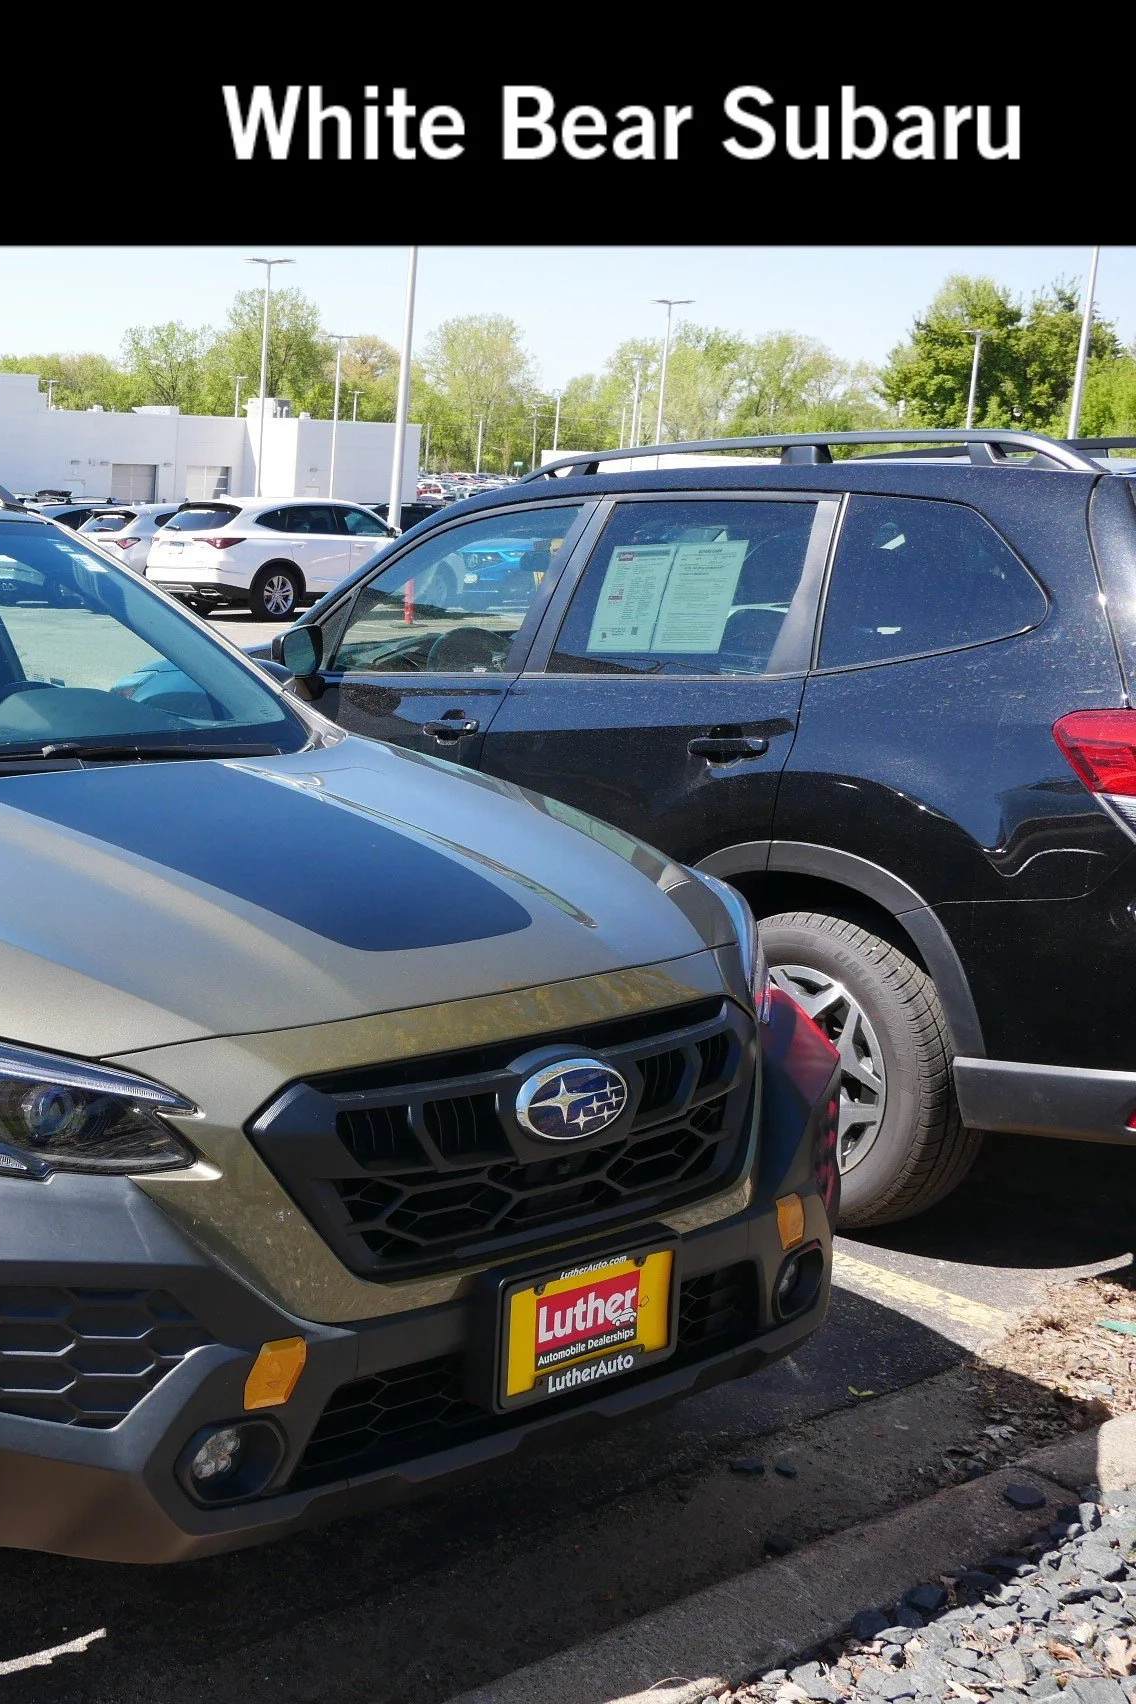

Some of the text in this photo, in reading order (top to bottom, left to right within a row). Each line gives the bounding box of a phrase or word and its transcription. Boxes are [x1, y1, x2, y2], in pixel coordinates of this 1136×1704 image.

[559, 1255, 628, 1281] LutherAuto.com
[538, 1286, 638, 1344] Luther
[537, 1327, 635, 1367] Automobile Dealerships
[547, 1354, 634, 1394] LutherAuto
